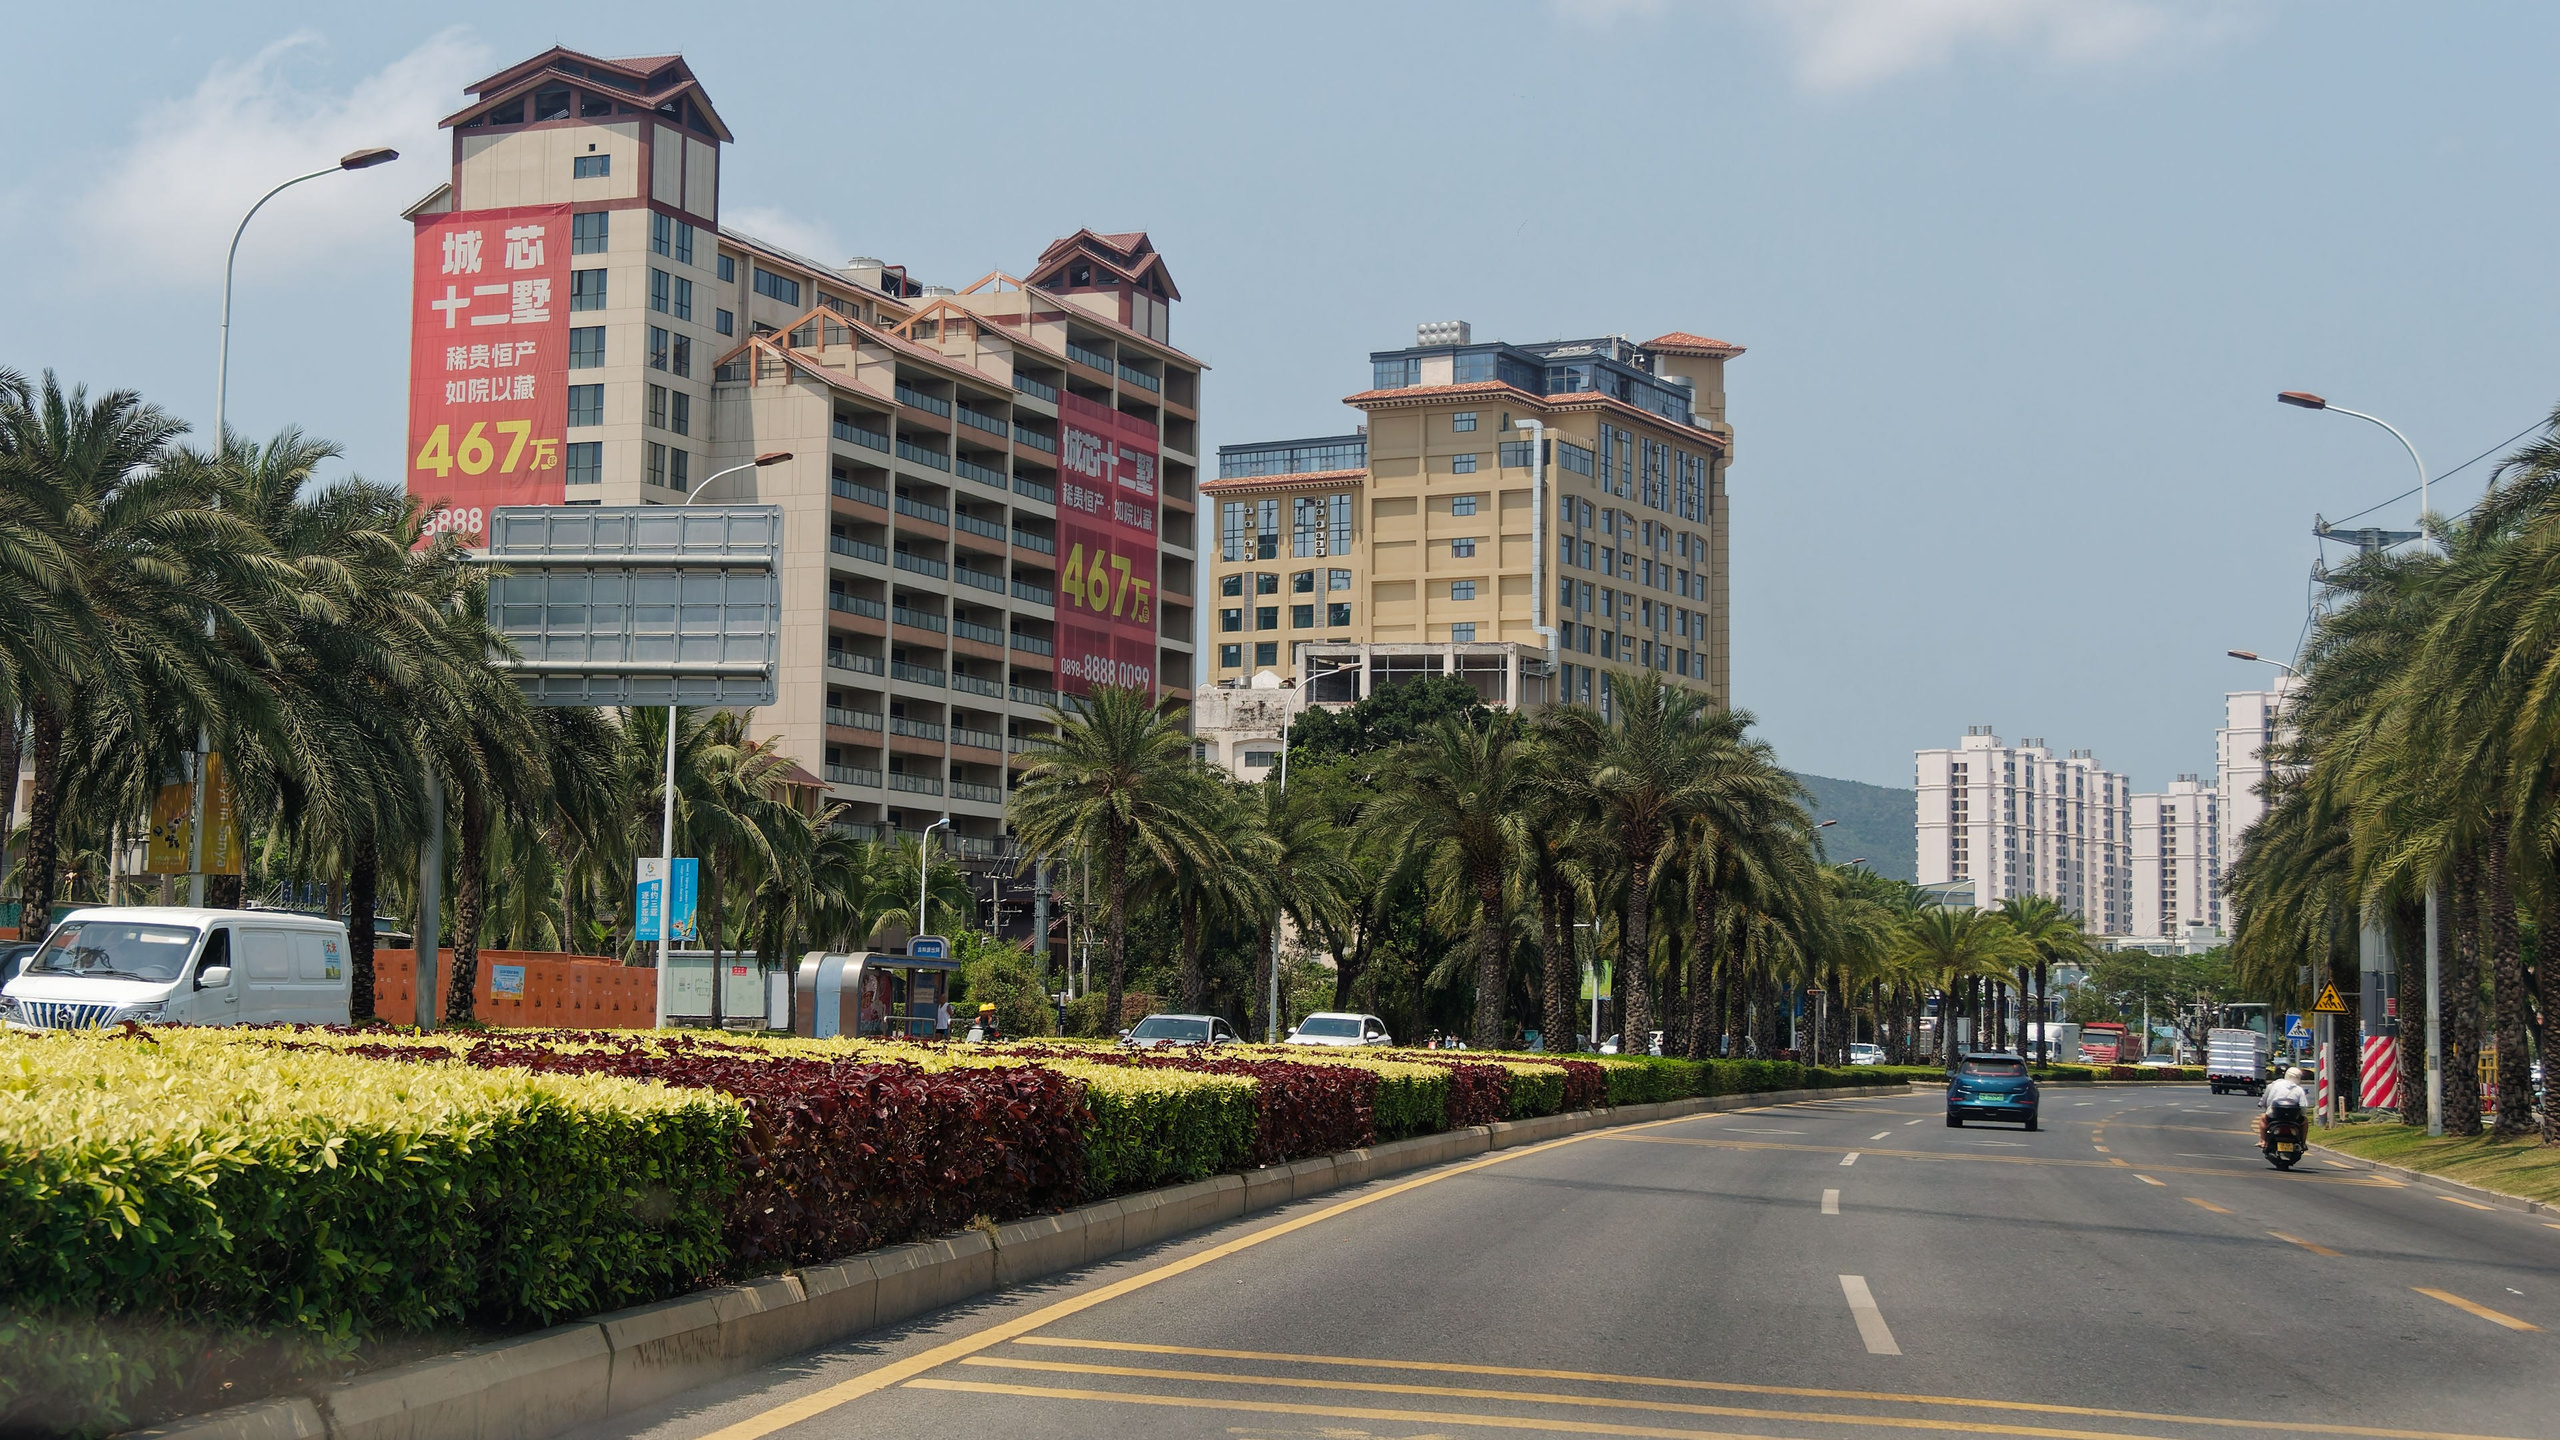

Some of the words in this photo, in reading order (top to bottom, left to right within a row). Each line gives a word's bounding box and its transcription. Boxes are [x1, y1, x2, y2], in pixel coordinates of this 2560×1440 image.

[432, 278, 552, 329] 十二墅
[446, 341, 536, 371] 稀贵恒产
[445, 374, 536, 405] 如院以藏
[1063, 426, 1154, 497] 城芯十二墅
[214, 825, 232, 868] Sanya
